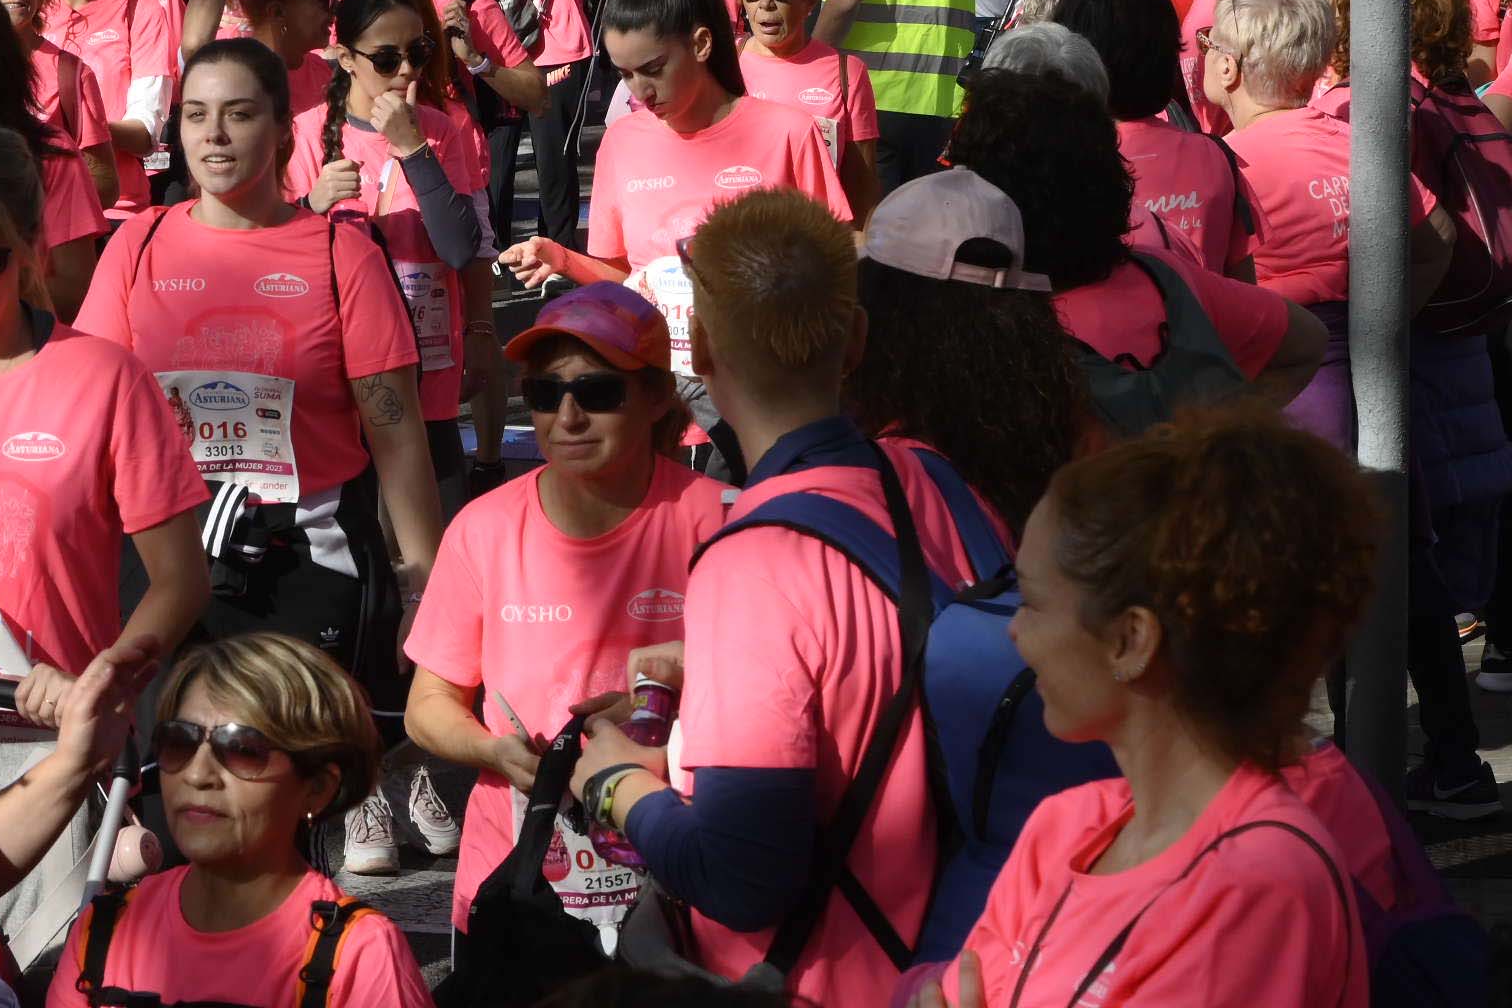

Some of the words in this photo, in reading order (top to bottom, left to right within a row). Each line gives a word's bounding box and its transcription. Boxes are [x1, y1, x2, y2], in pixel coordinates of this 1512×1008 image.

[546, 63, 571, 87] NIKE
[627, 175, 676, 193] OYSHO
[717, 175, 760, 186] ASTURIANA
[257, 281, 306, 293] ASTURIANA
[193, 390, 246, 405] ASTURIANA
[253, 391, 281, 401] SUMA
[199, 422, 248, 440] 016
[6, 442, 61, 454] ASTURIANA
[204, 445, 244, 458] 33013
[209, 463, 220, 472] DE
[221, 463, 233, 472] LA
[235, 462, 263, 473] MUJER
[500, 603, 573, 623] OYSHO
[584, 872, 632, 890] 21557
[591, 891, 607, 903] DE
[608, 890, 622, 902] LA
